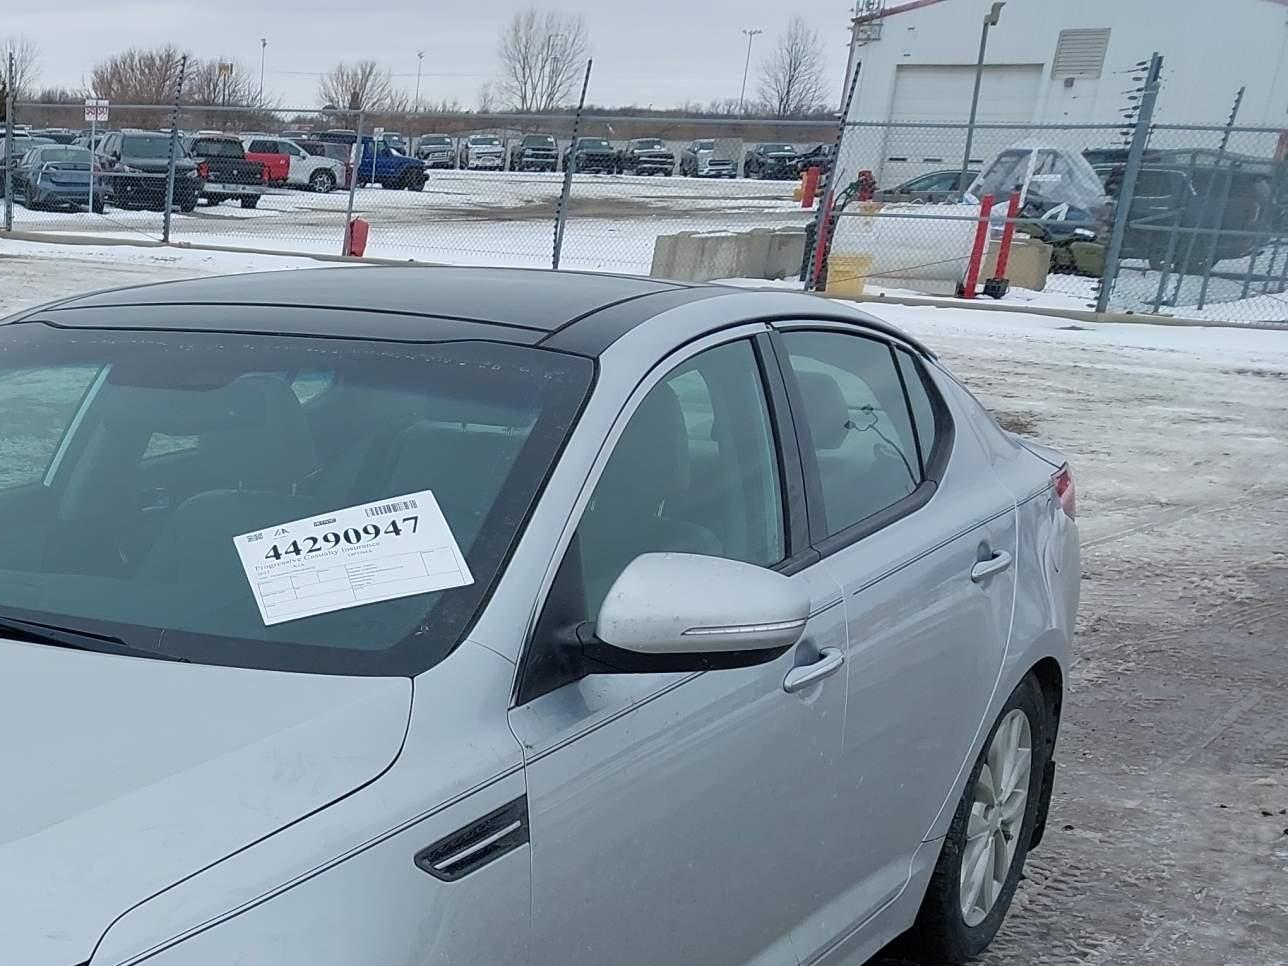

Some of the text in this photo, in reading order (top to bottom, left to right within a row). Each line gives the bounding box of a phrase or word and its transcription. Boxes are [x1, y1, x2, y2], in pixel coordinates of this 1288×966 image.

[255, 542, 380, 572] Progressive Casualty Insurance
[264, 515, 419, 561] 44290947
